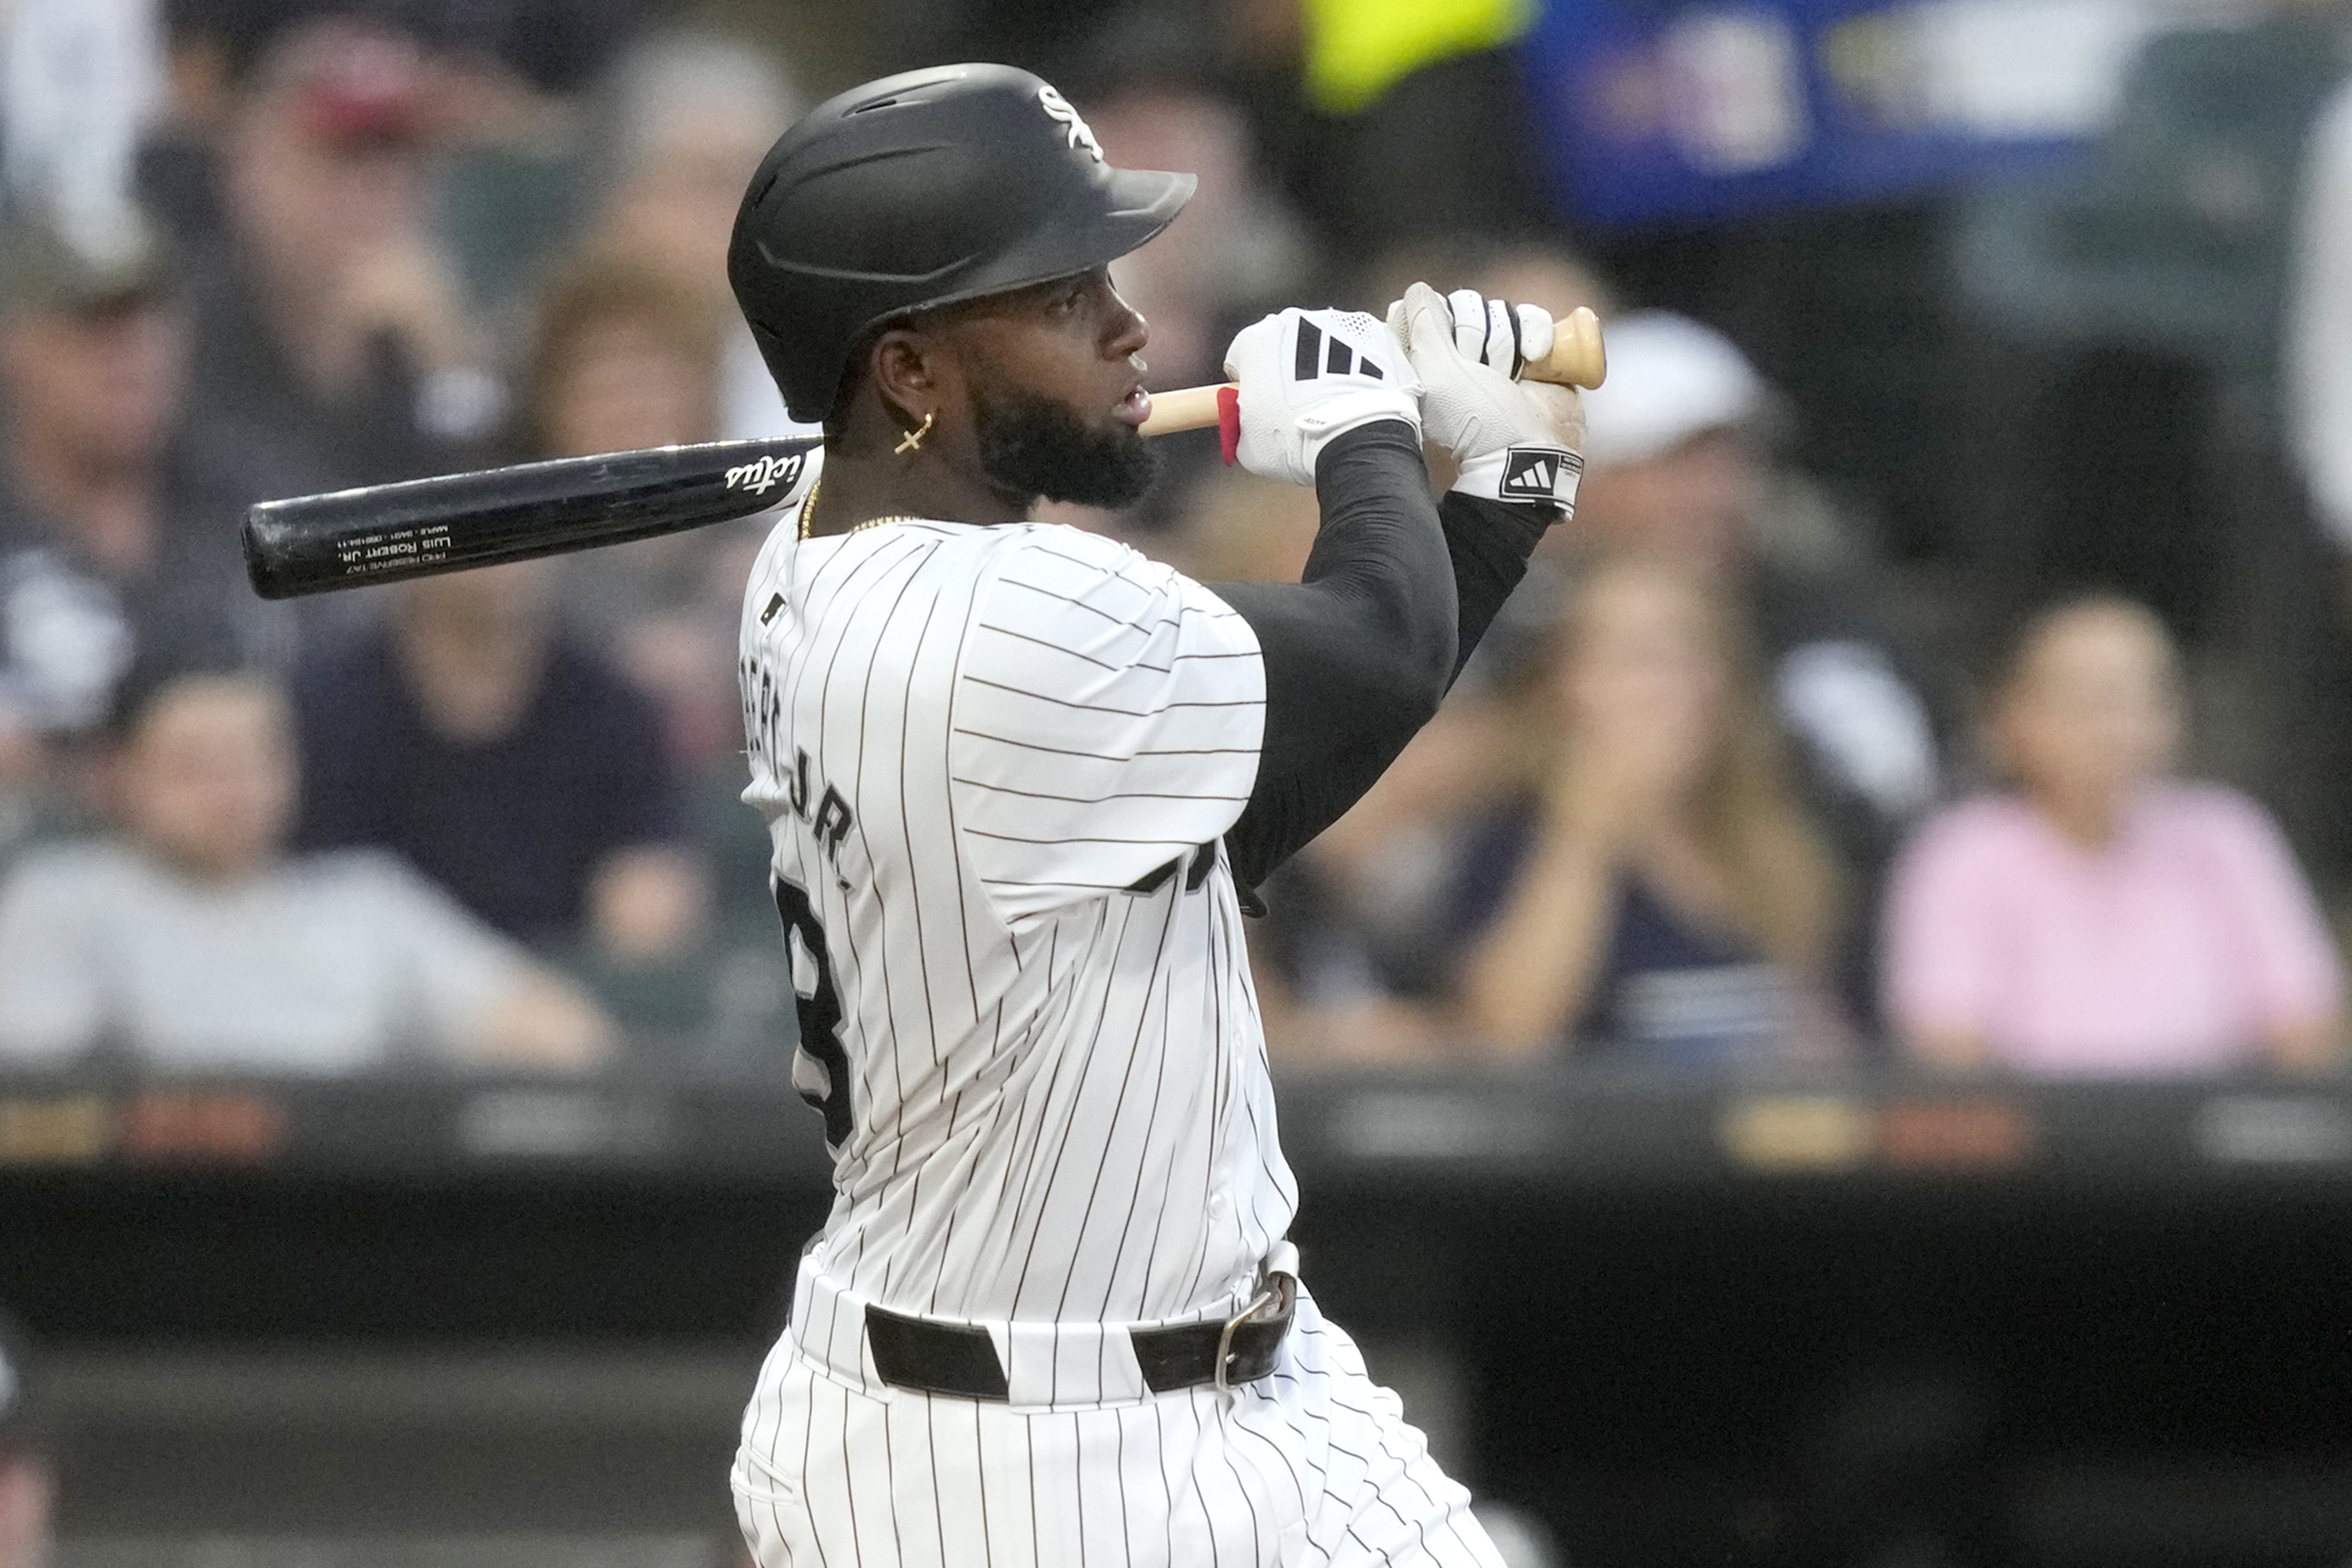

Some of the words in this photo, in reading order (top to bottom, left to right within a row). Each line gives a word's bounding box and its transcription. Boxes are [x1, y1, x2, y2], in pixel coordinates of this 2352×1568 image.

[420, 525, 448, 535] MAPLE
[423, 536, 451, 550] LUIS
[365, 542, 417, 559] ROBERT
